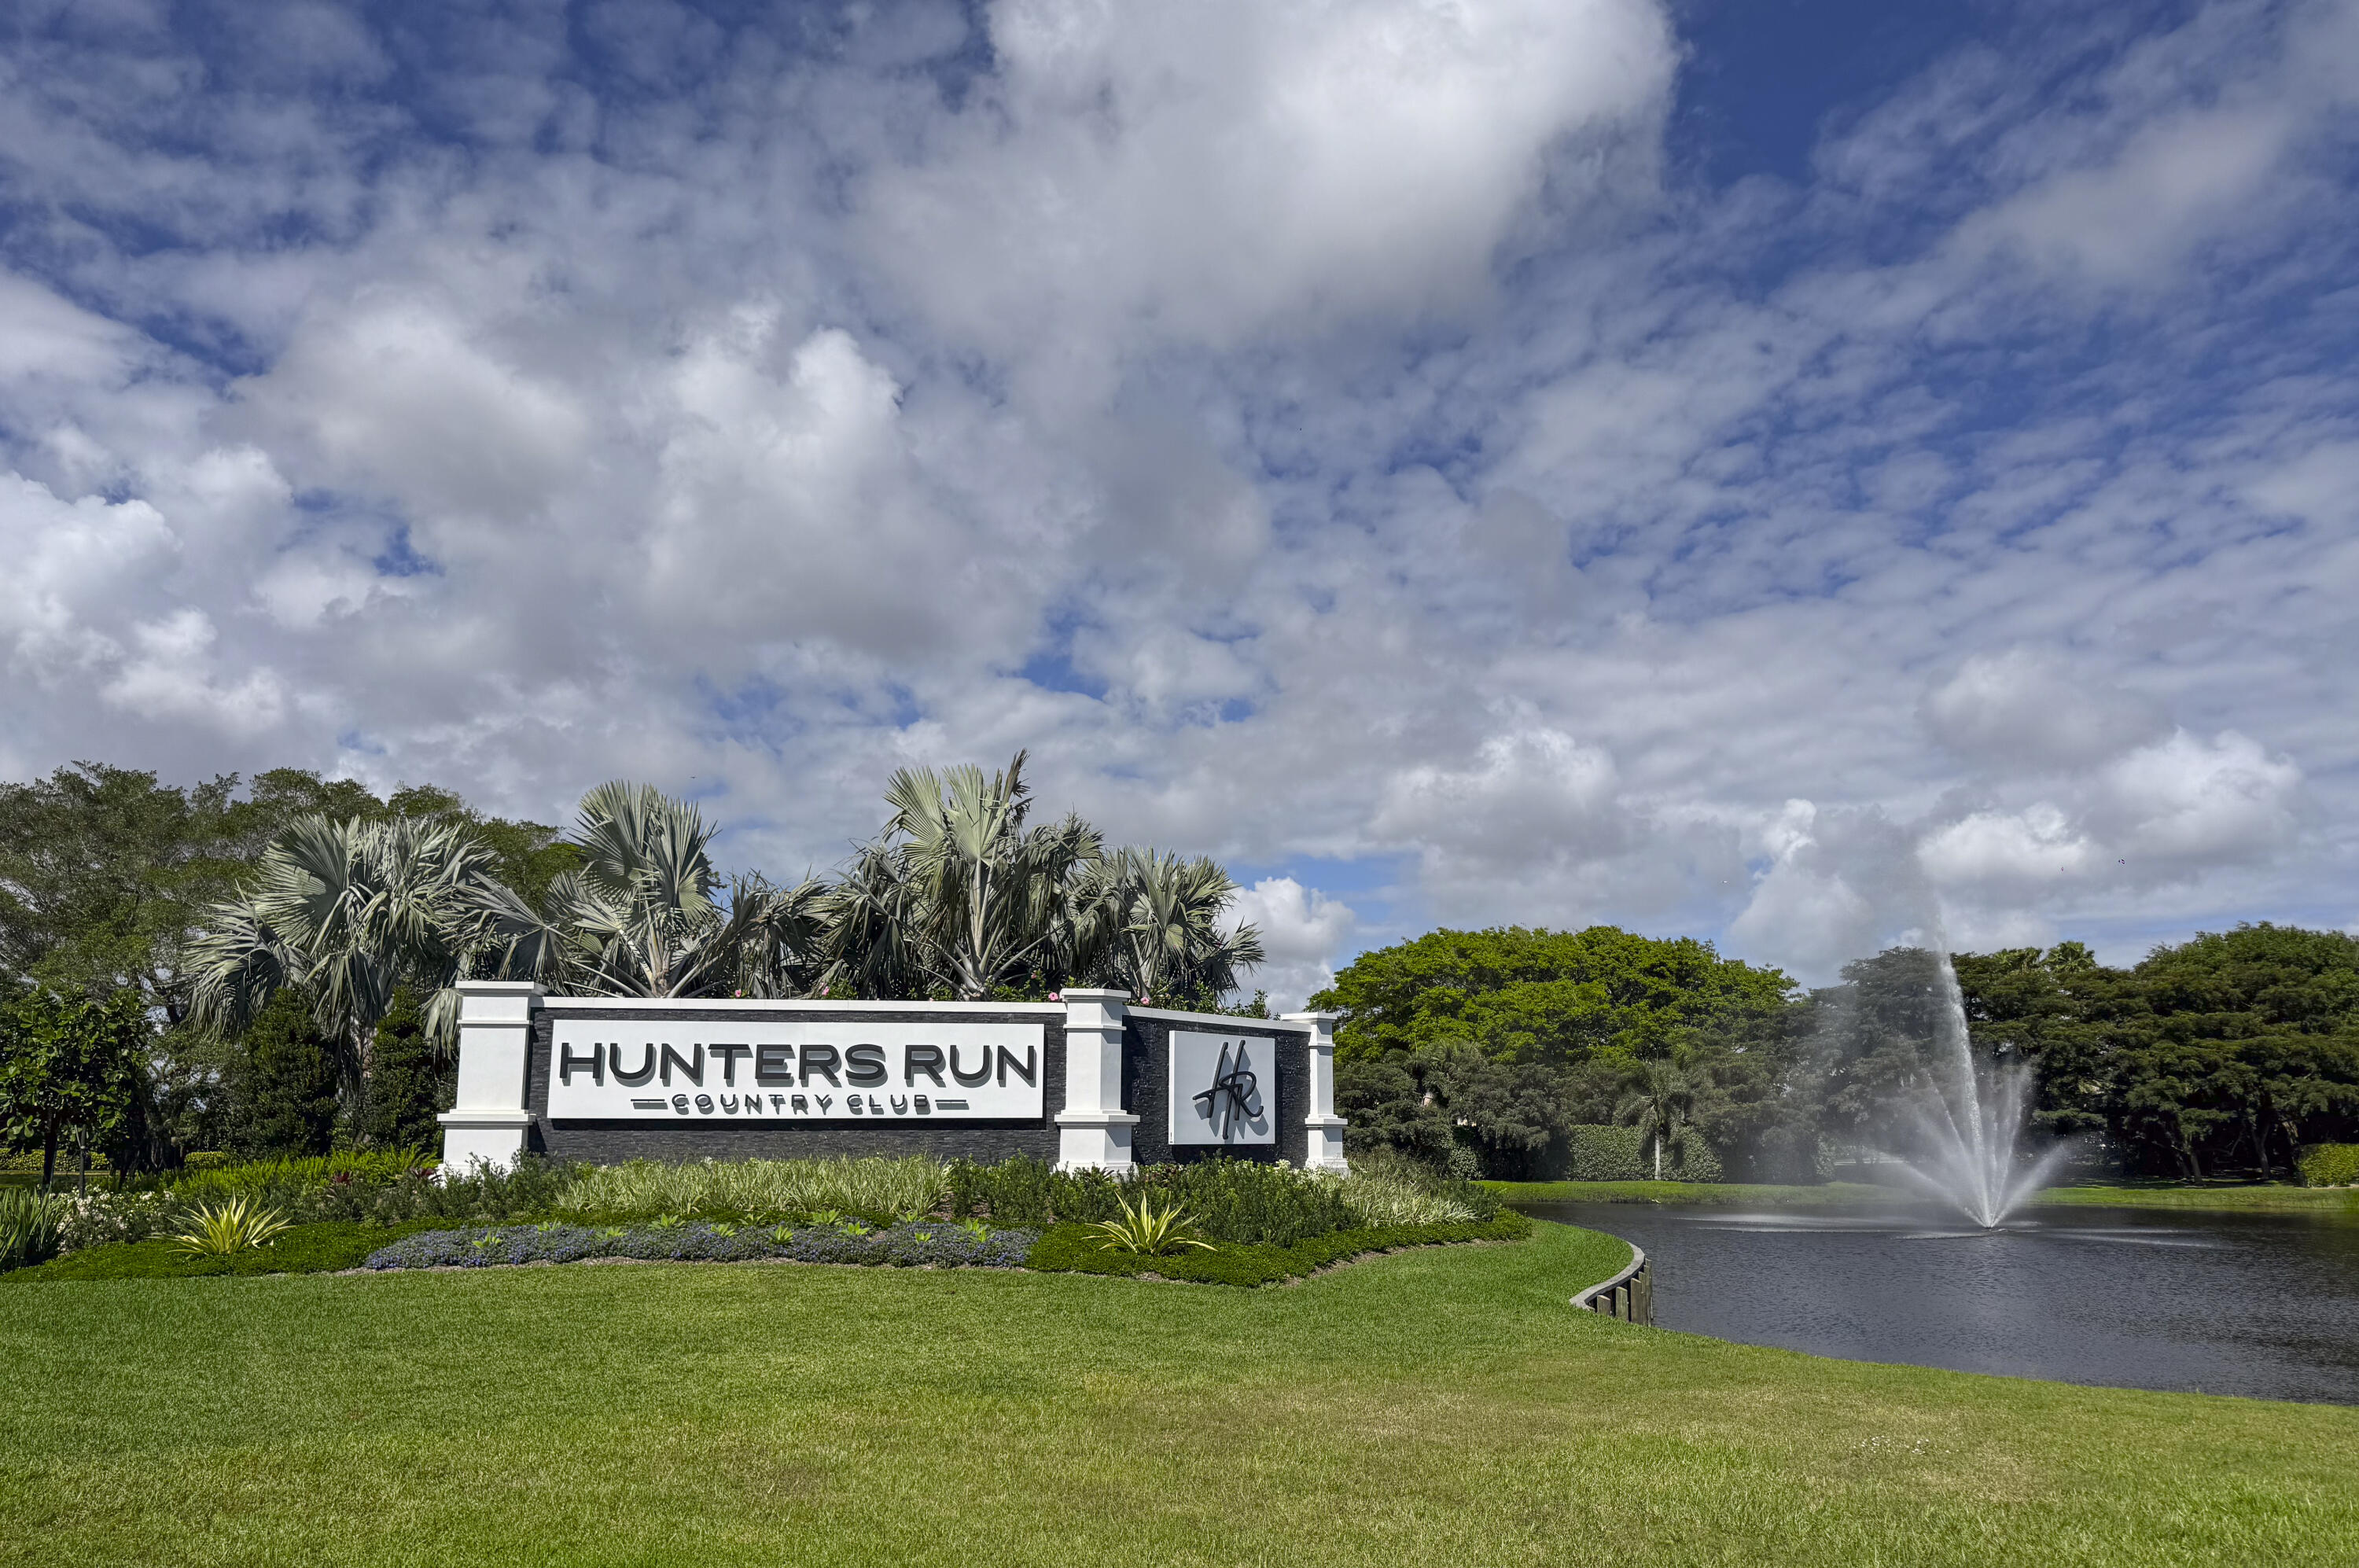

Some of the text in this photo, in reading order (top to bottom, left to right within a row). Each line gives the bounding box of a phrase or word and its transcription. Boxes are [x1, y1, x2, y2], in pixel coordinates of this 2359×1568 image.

[559, 1043, 1035, 1081] HUNTERS RUN
[671, 1094, 929, 1109] COUNTRY CLUB
